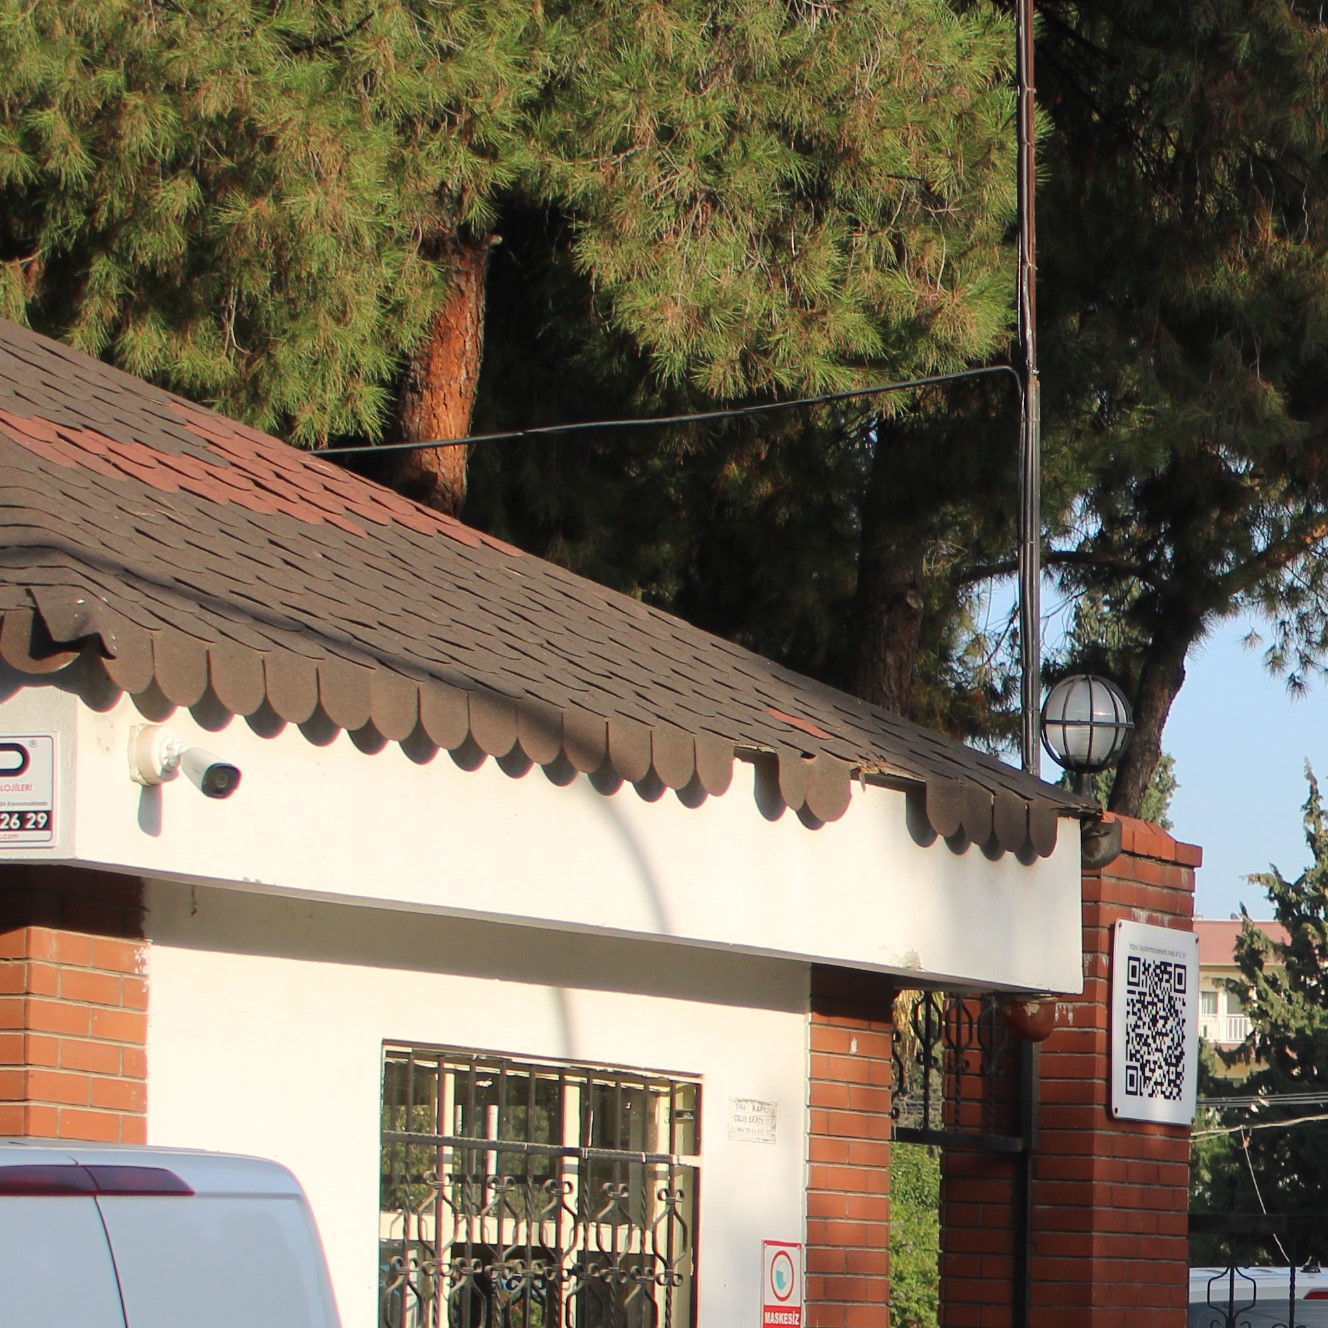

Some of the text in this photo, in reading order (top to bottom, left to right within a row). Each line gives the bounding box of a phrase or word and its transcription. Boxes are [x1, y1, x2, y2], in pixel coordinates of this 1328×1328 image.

[0, 812, 48, 829] 26 29
[764, 1311, 800, 1325] MASKESİZ
